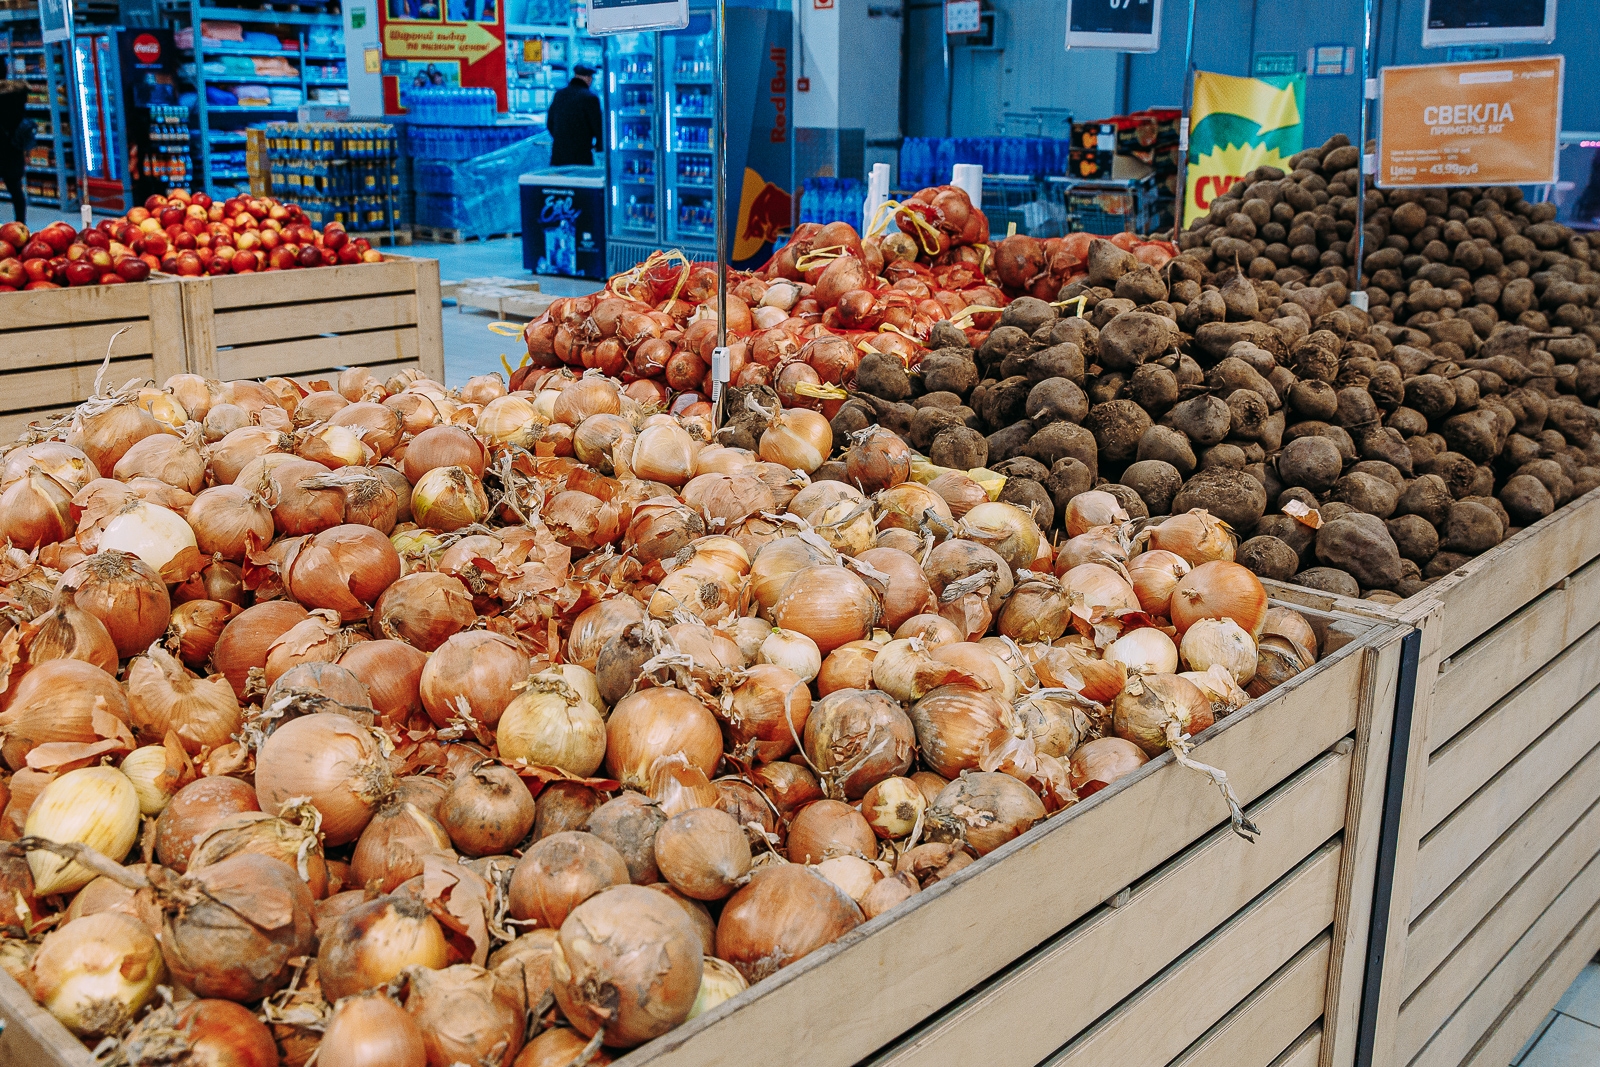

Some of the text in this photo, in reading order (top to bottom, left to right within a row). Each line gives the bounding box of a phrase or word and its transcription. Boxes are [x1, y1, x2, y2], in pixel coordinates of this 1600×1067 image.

[770, 47, 786, 143] Red Bull
[1423, 102, 1515, 126] СВЕКЛА
[1430, 124, 1485, 135] ПРИМОРЬЕ
[1390, 165, 1417, 177] Цена
